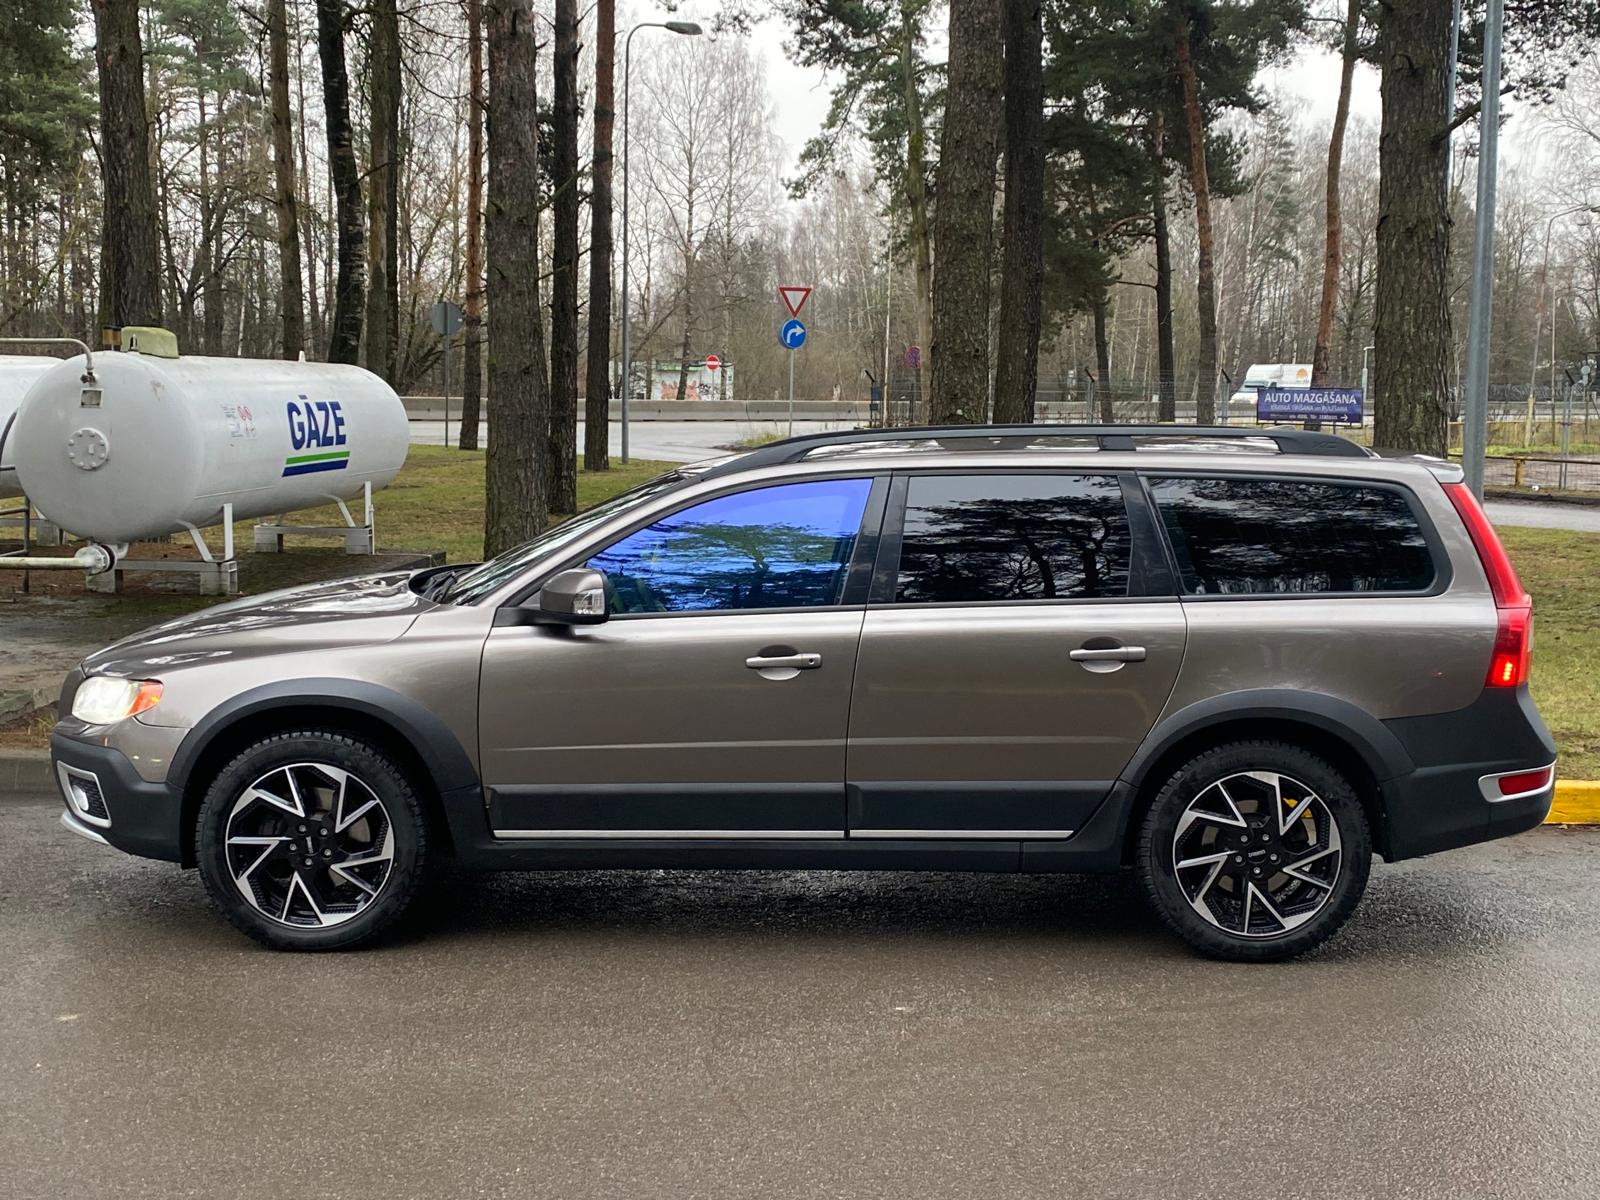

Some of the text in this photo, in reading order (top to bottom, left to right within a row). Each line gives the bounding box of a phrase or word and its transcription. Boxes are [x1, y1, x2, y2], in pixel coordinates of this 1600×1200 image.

[1264, 391, 1357, 404] AUTO MAZGĀŠANA
[286, 394, 347, 450] GĀZE
